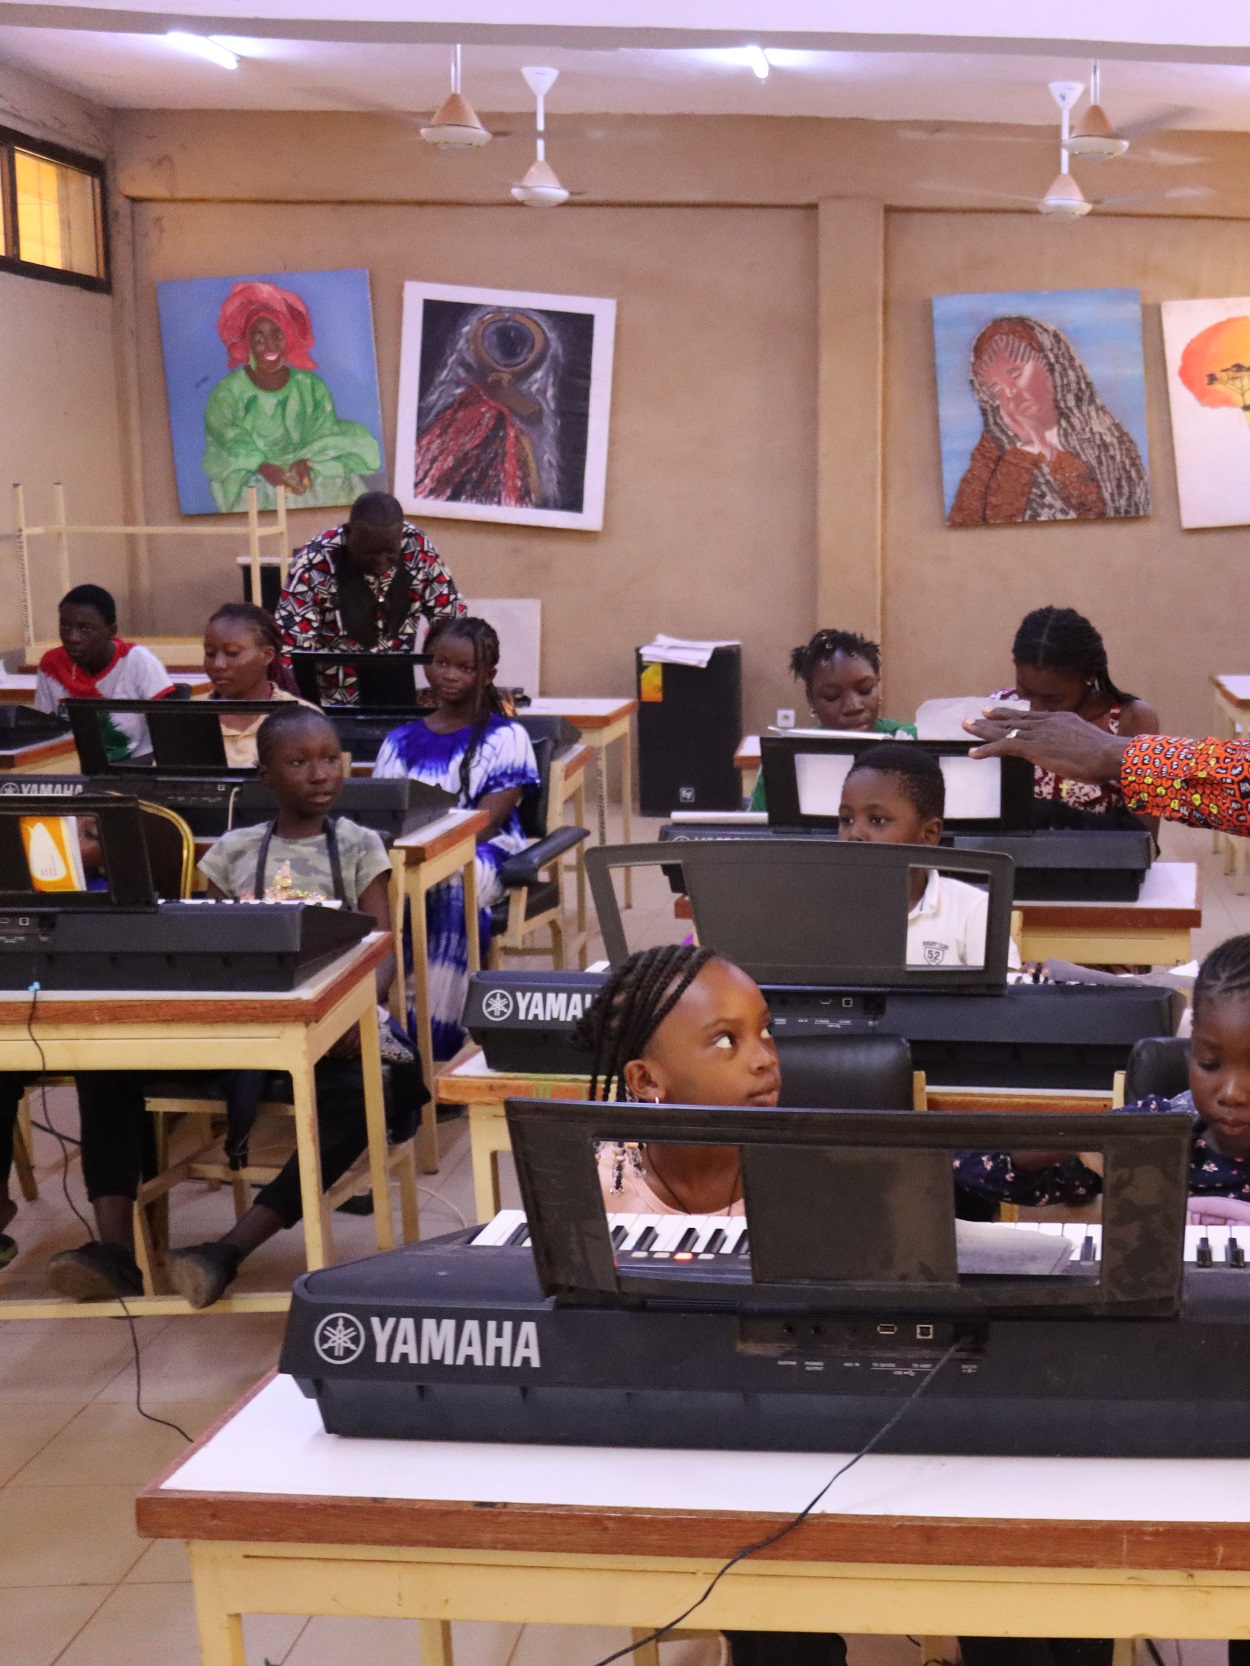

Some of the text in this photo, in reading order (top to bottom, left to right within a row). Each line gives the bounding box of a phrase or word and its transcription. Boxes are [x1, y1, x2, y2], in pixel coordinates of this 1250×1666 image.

[927, 949, 940, 961] 52
[515, 991, 597, 1022] YAMA
[370, 1316, 541, 1369] YAMAHA
